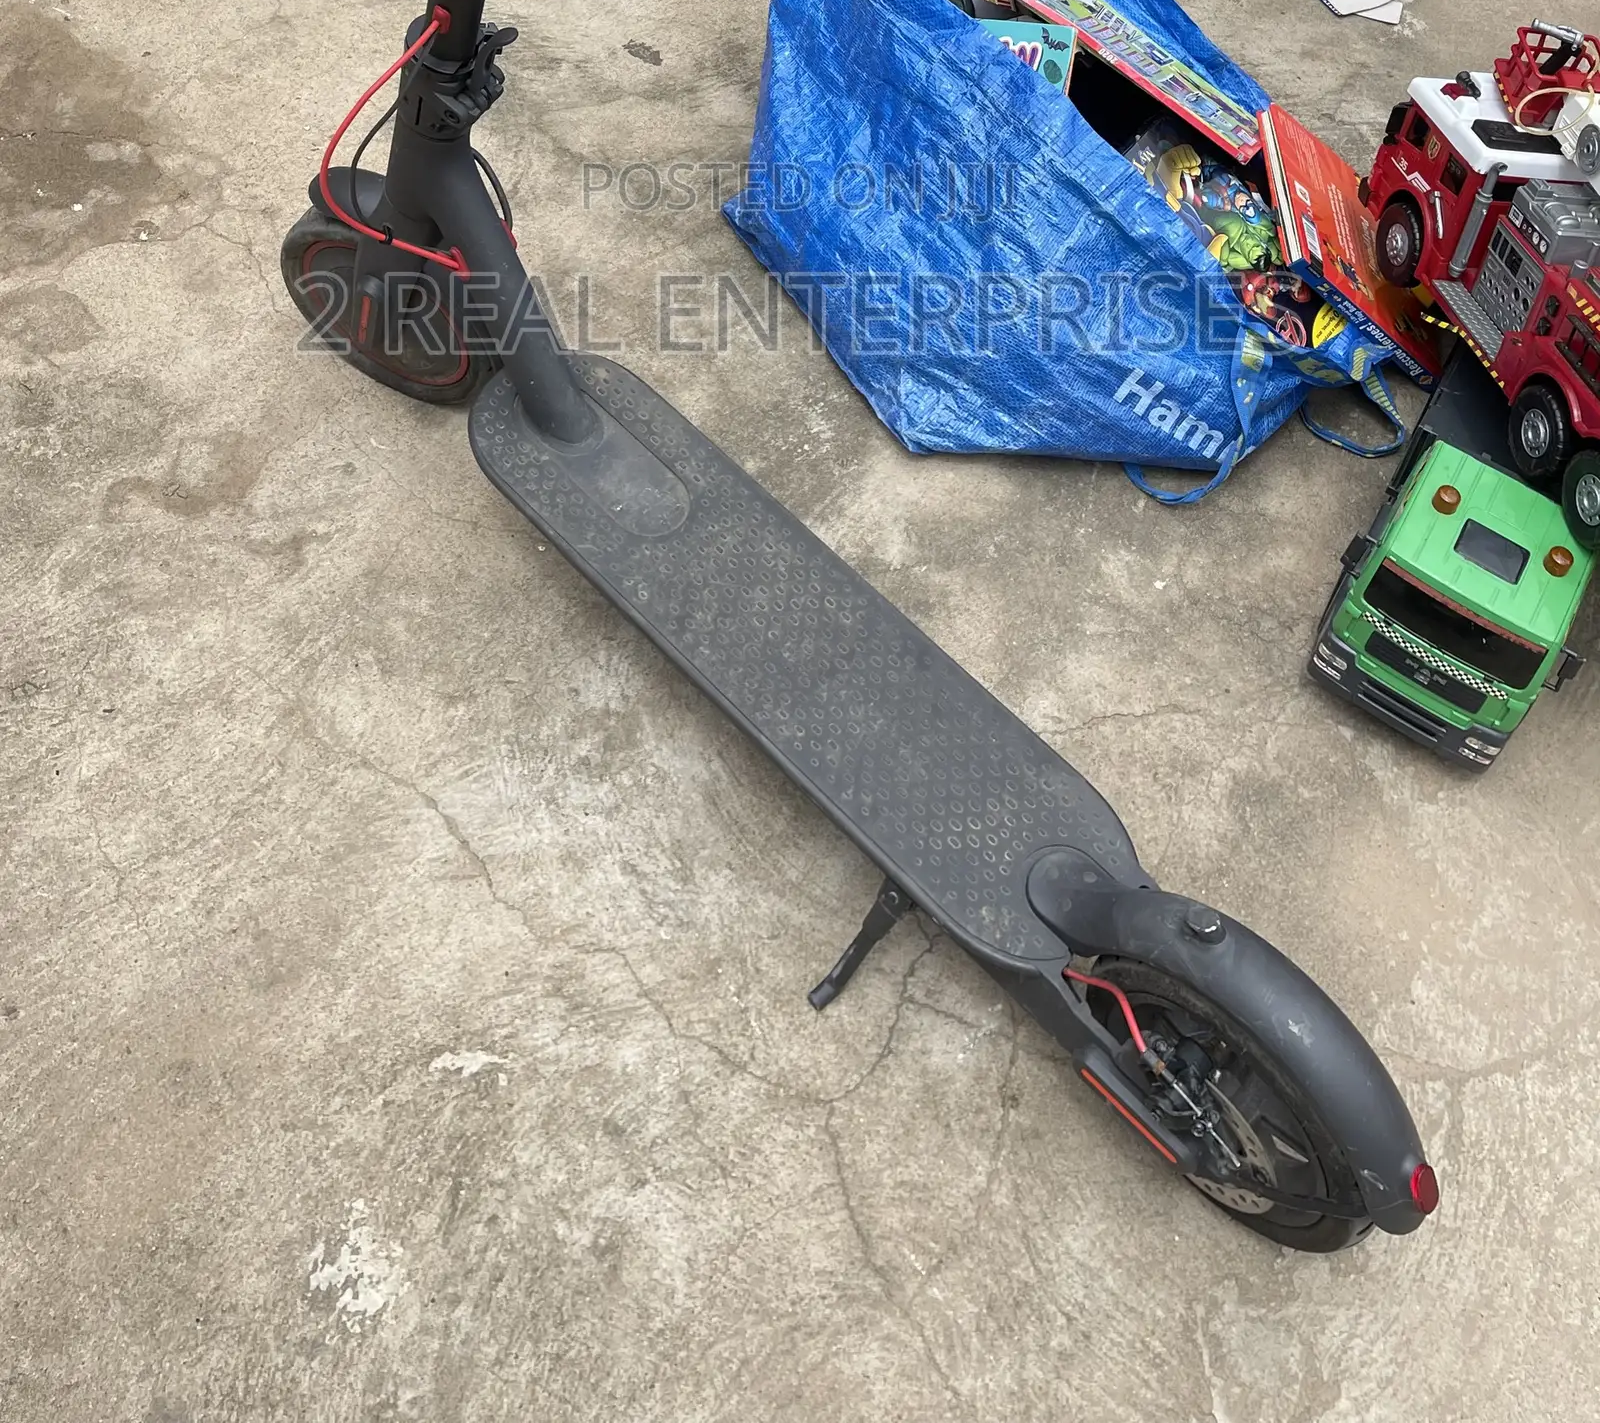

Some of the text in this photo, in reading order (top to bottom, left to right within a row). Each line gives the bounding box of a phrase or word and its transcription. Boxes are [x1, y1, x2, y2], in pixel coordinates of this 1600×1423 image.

[1098, 48, 1118, 65] 2020
[1400, 157, 1409, 170] 35
[1393, 348, 1423, 377] Rescue
